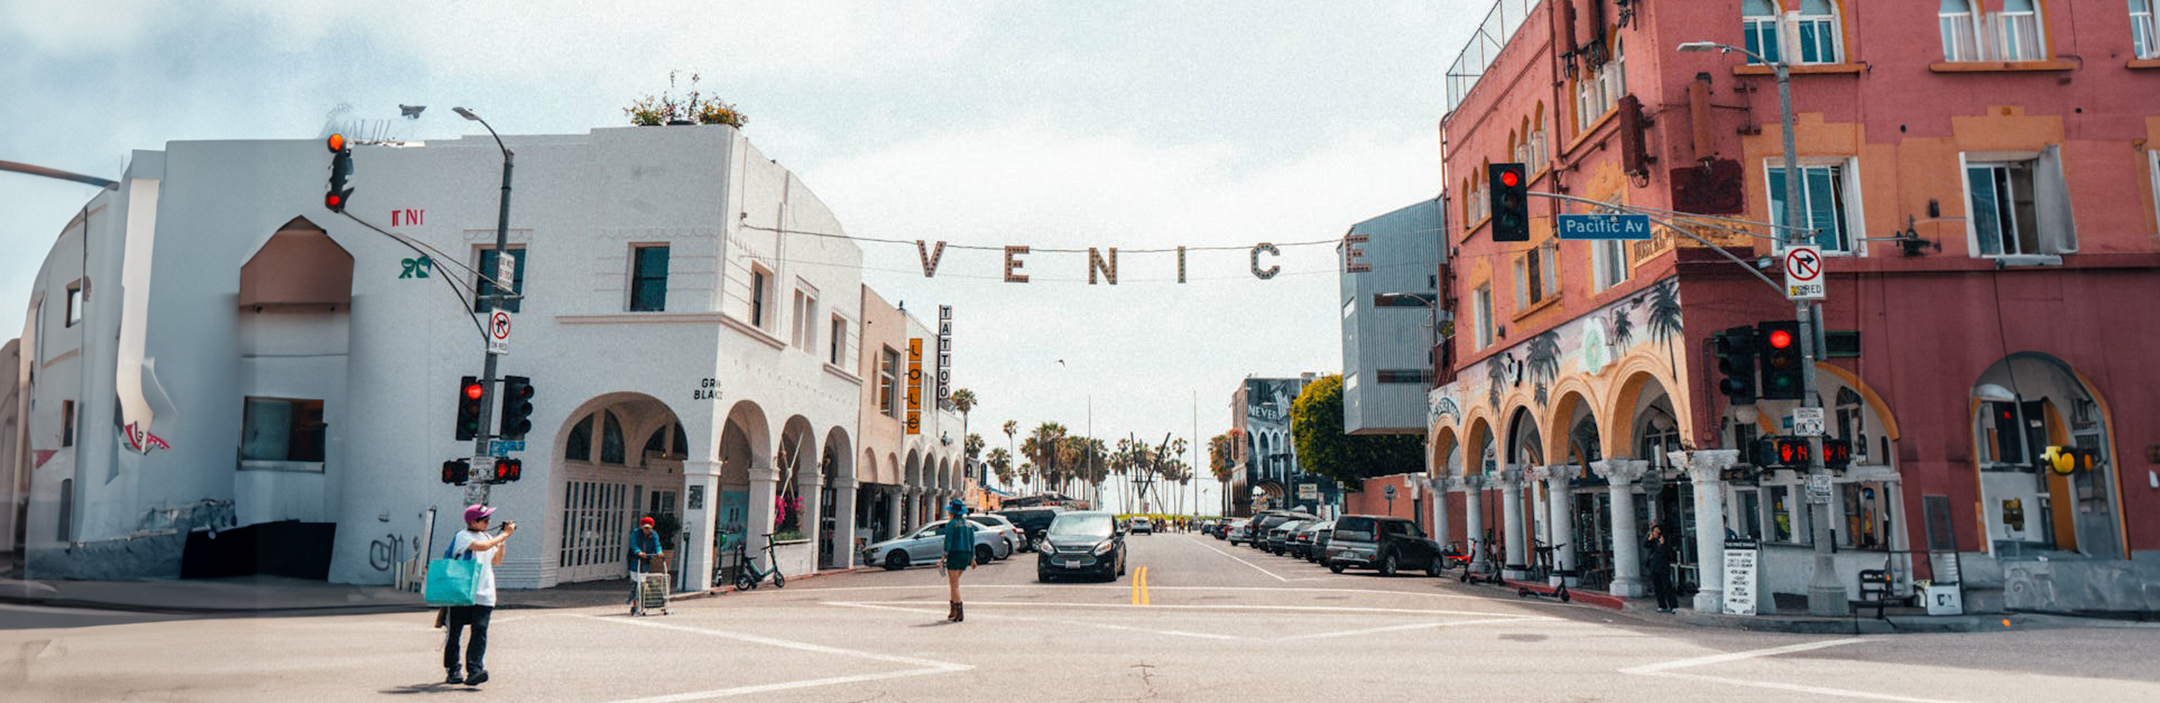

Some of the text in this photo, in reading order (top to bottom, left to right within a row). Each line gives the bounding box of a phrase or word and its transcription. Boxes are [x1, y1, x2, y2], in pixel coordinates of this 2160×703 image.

[1566, 219, 1643, 233] Pacific Av
[916, 235, 1372, 285] VENICE
[939, 305, 951, 398] TATTOO
